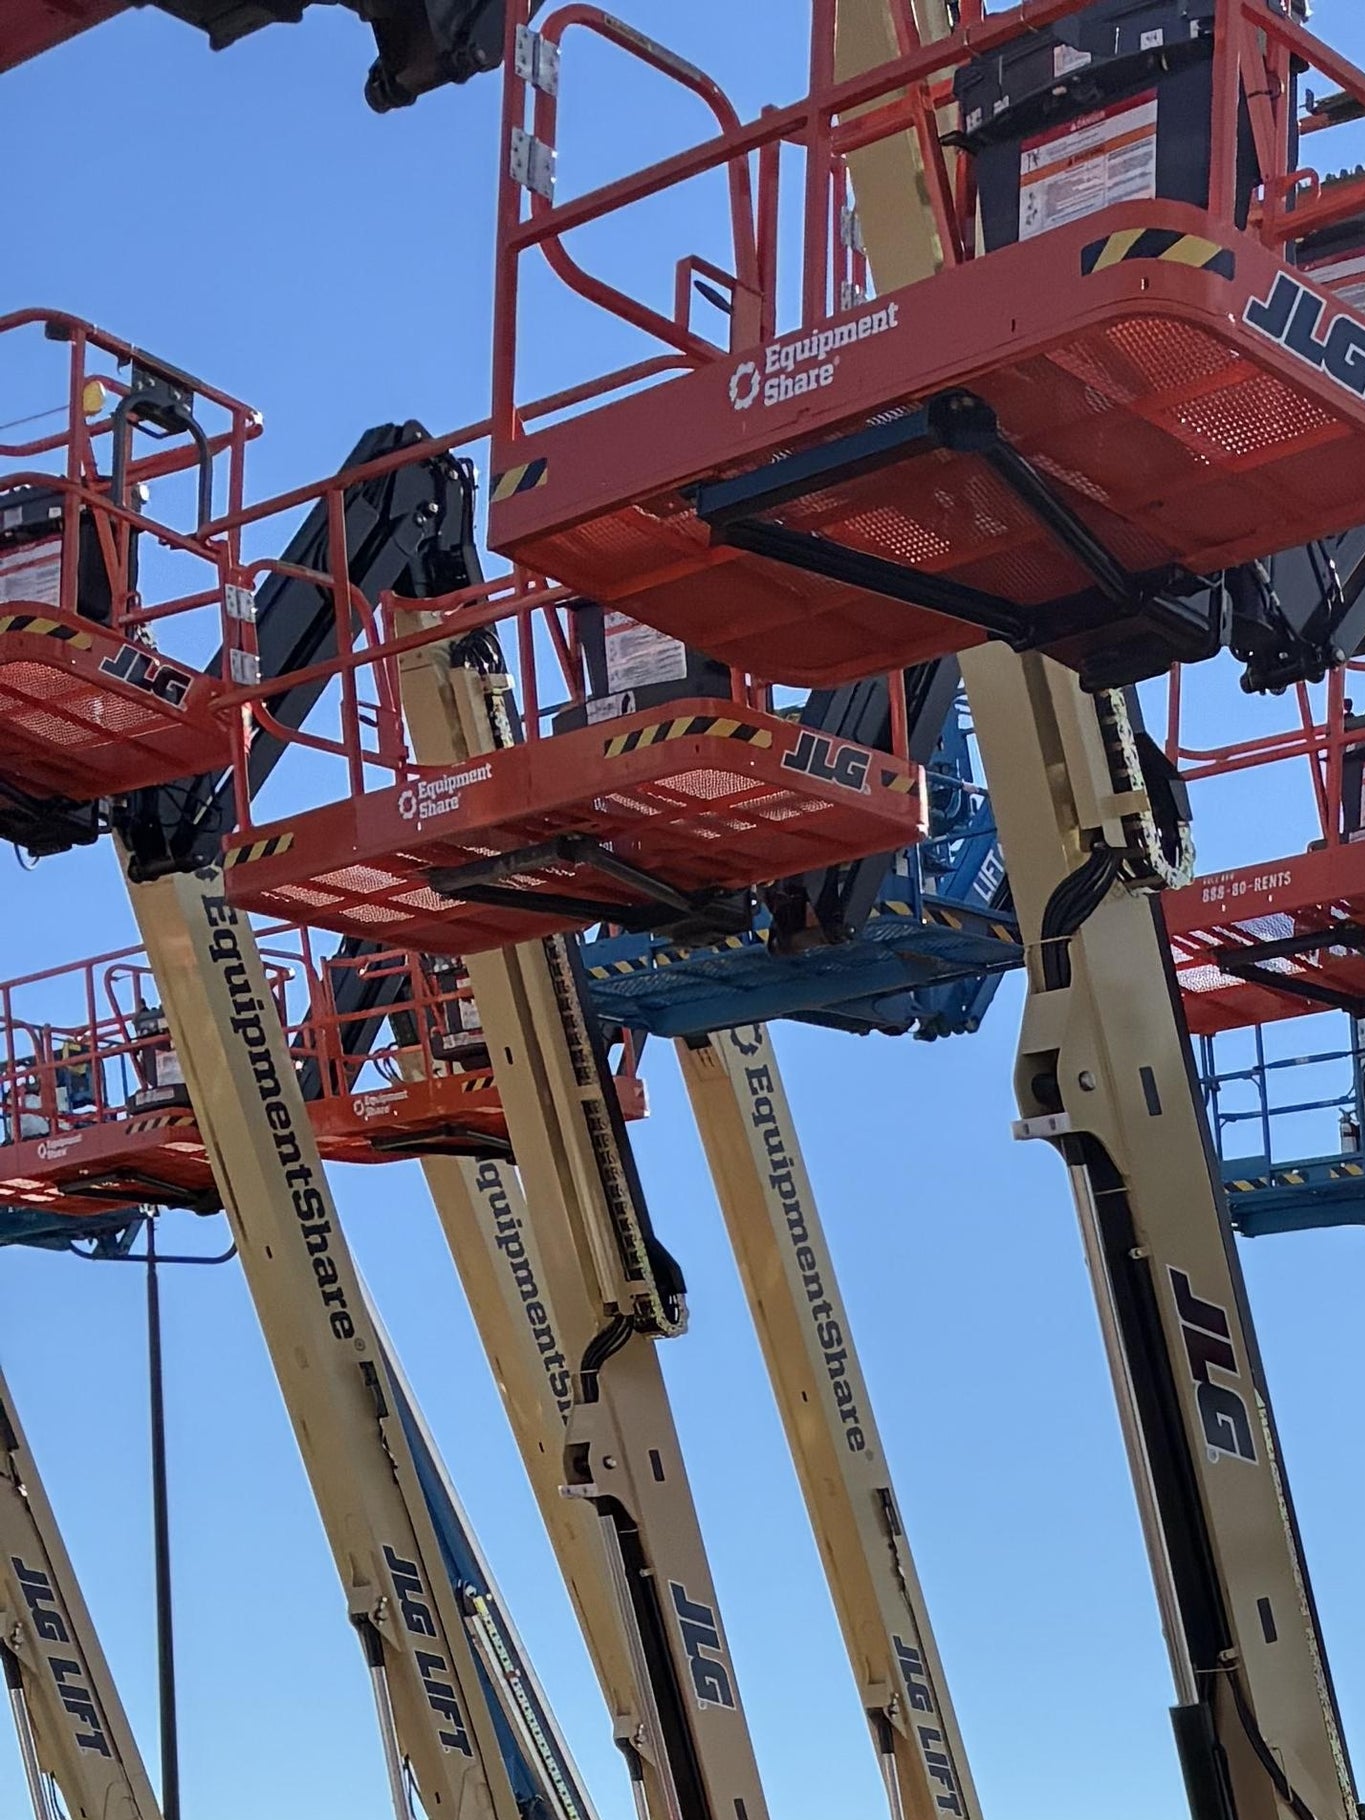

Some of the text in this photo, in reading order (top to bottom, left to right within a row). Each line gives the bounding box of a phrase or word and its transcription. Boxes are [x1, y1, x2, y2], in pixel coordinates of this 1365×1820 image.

[763, 360, 834, 407] Share
[764, 302, 899, 373] Equipment
[98, 643, 194, 709] JLG
[417, 762, 492, 799] Equipment
[418, 794, 460, 819] Share
[781, 730, 873, 793] JLG
[1201, 870, 1292, 903] 888-80-RENTS
[201, 892, 355, 1341] EquipmentShare
[745, 1064, 866, 1453] EquipmentShare
[1166, 1264, 1260, 1466] JLG
[11, 1556, 113, 1760] JLG LIFT
[382, 1544, 474, 1759] JLG LIFT
[668, 1579, 738, 1711] JLG
[893, 1635, 964, 1820] JLG LIFT
